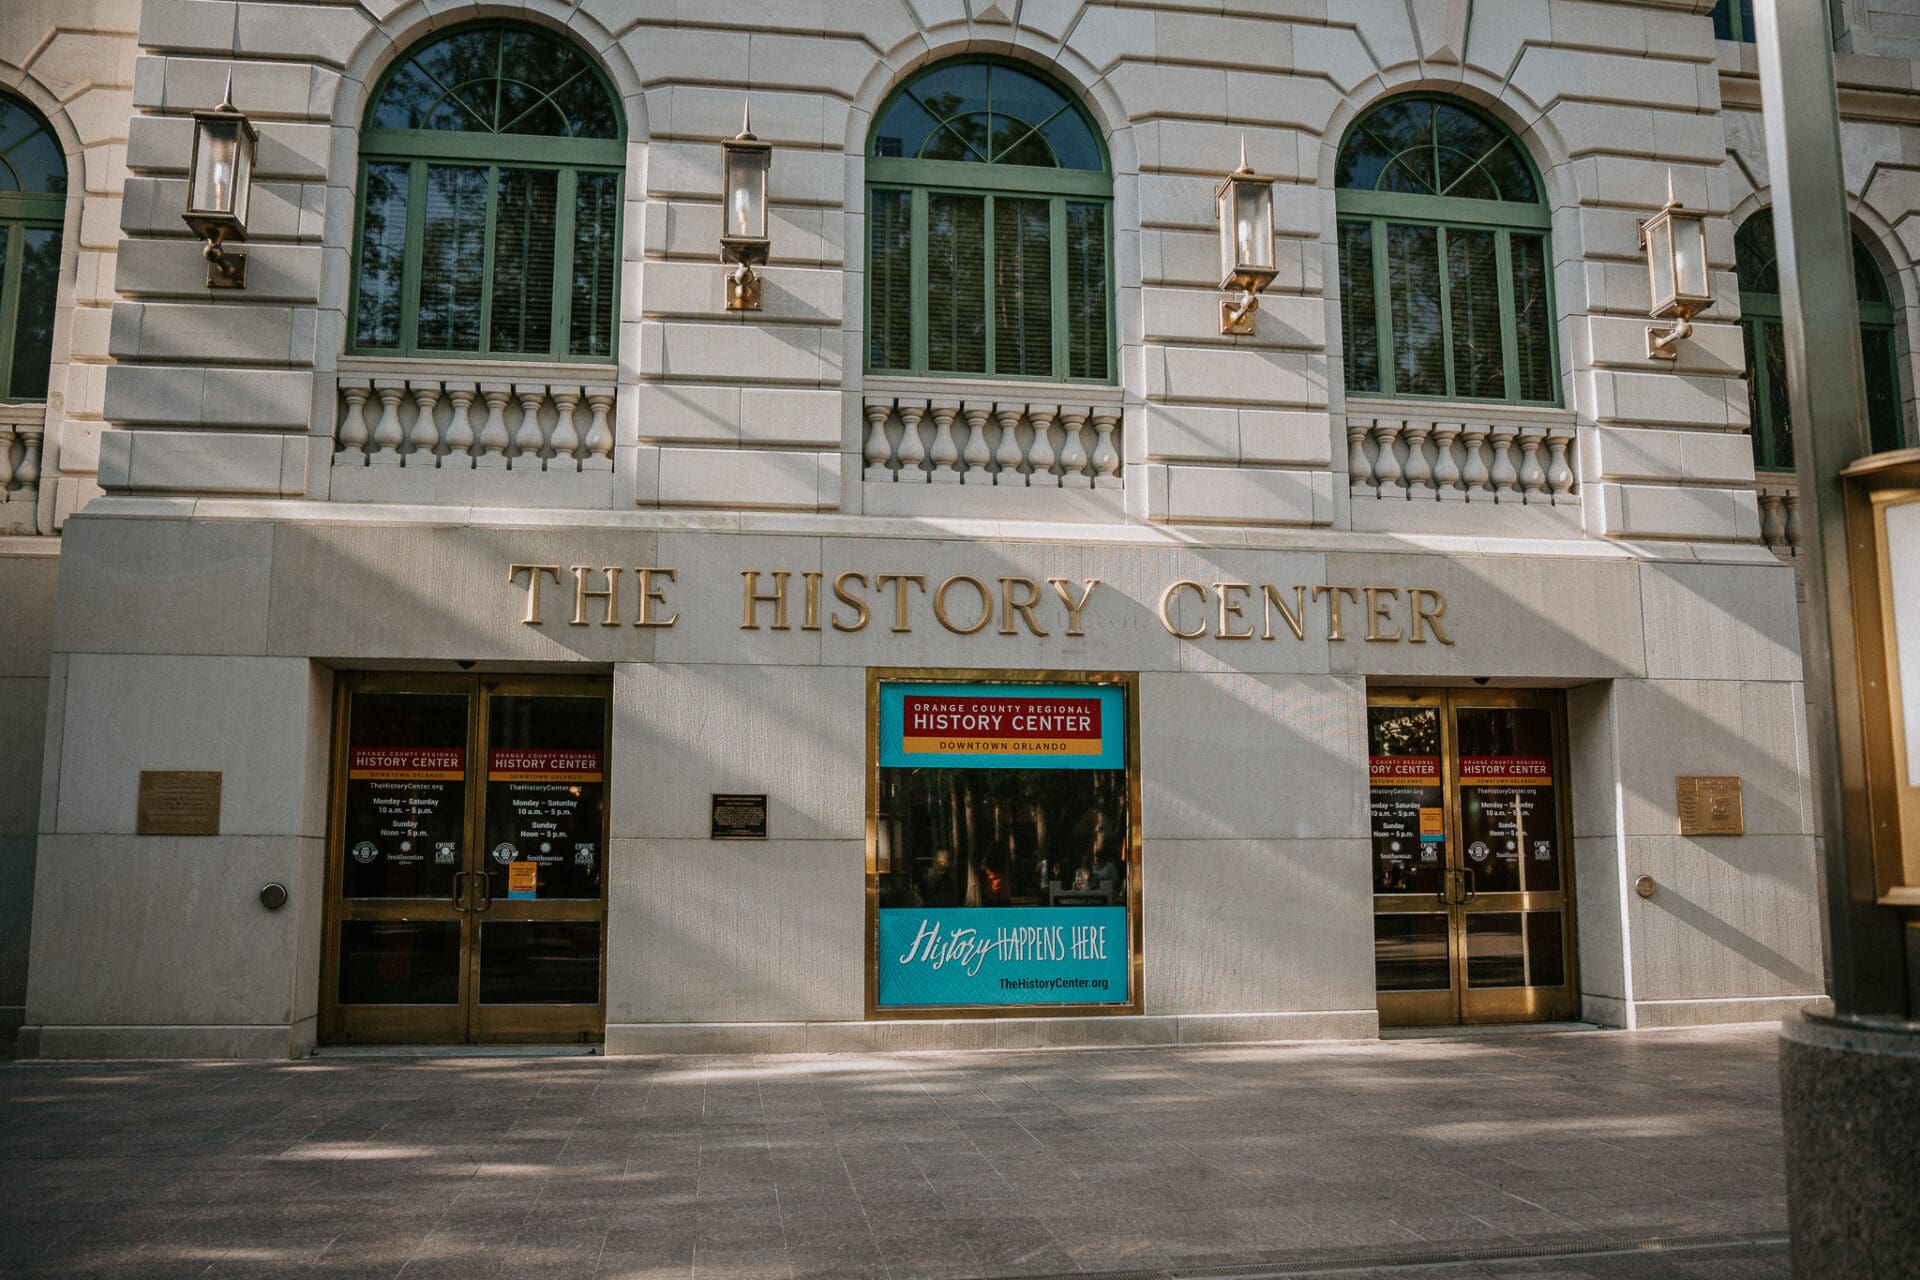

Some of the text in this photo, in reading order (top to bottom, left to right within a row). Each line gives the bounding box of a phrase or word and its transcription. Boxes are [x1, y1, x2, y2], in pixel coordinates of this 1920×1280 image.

[509, 563, 1455, 646] THE HISTORY CENTER
[914, 703, 1091, 715] ORANGE COUNTY REGIONAL
[914, 714, 1091, 732] HISTORY CENTER
[939, 741, 1067, 751] DOWNTOWN ORLANDO
[356, 757, 459, 768] HISTORY CENTER
[495, 759, 597, 769] HISTORY CENTER
[1395, 765, 1435, 774] CENTER
[1464, 765, 1546, 774] HISTORY CENTER
[370, 782, 444, 791] TheHistoryCenter.org
[373, 798, 401, 806] Monday
[408, 798, 439, 807] Saturday
[512, 799, 540, 808] Monday
[547, 799, 578, 808] Saturday
[1394, 802, 1421, 810] Saturday
[378, 806, 387, 814] 10
[392, 820, 418, 829] Sunday
[531, 821, 558, 830] Sunday
[1382, 822, 1405, 830] Sunday
[552, 831, 568, 839] p.m.
[386, 853, 424, 861] Smithsonian
[526, 854, 564, 862] Smithsonian
[900, 918, 1107, 977] History HAPPENS HERE
[999, 977, 1109, 990] TheHistoryCenter.org
